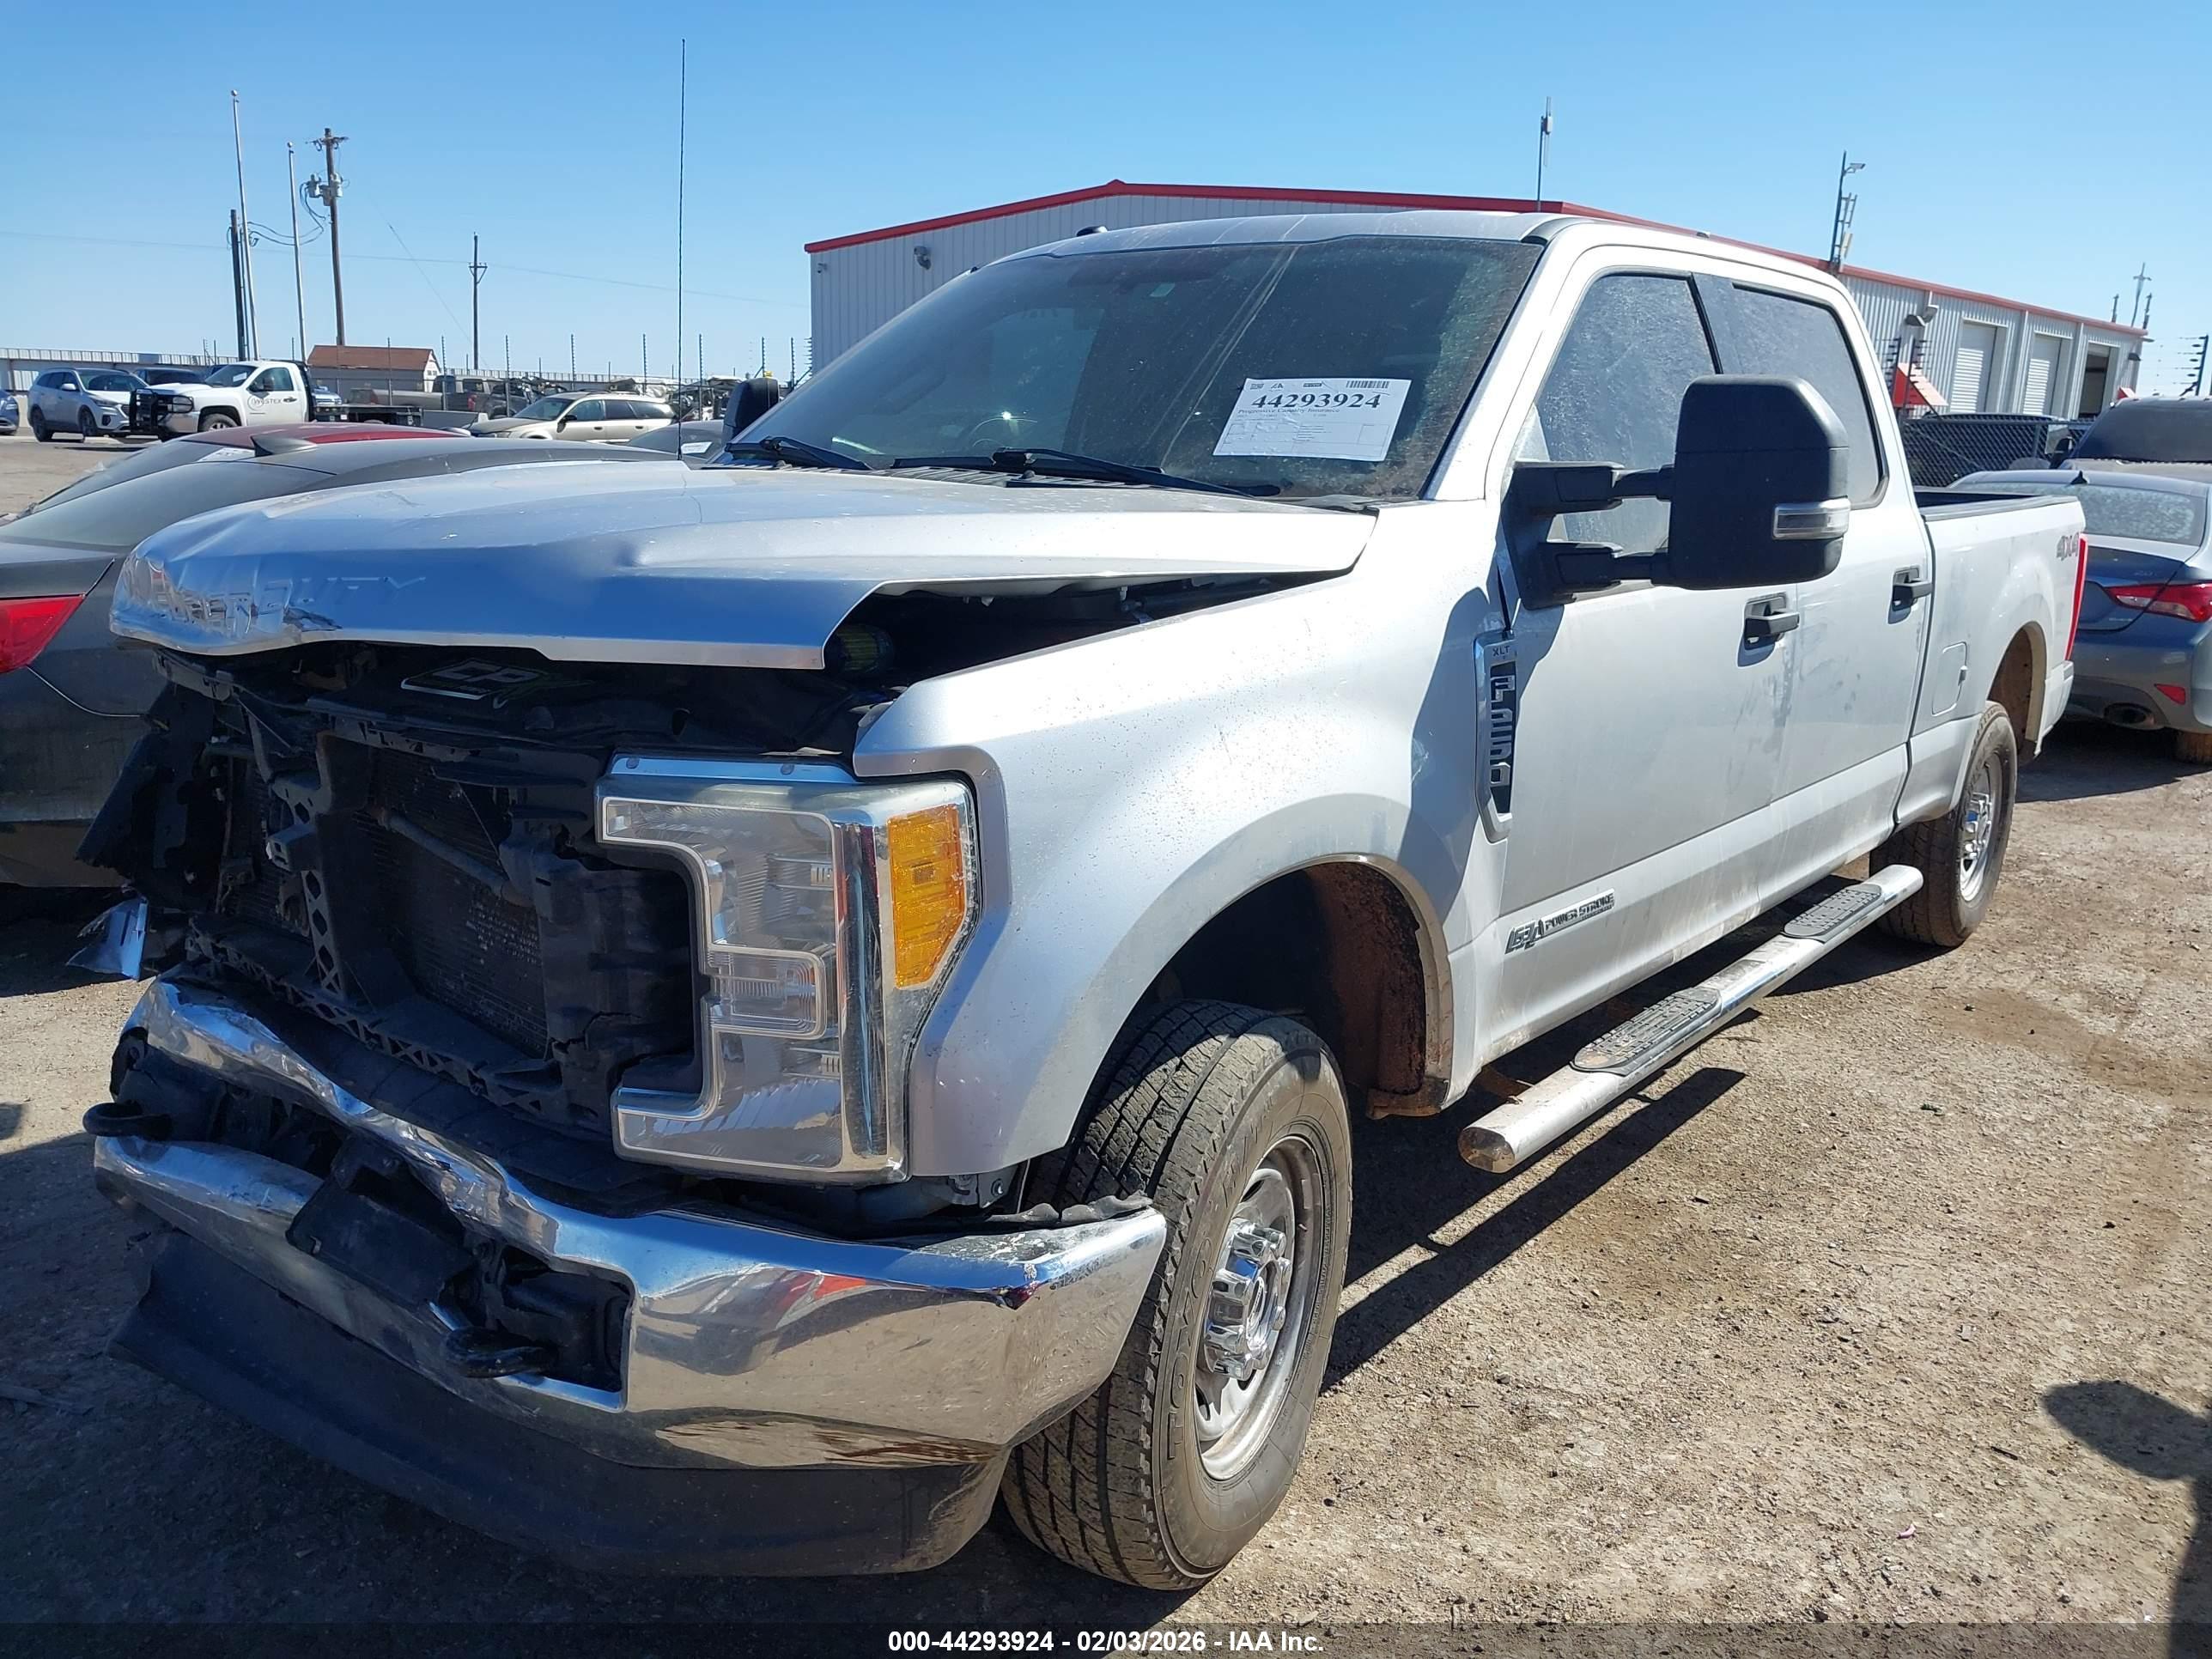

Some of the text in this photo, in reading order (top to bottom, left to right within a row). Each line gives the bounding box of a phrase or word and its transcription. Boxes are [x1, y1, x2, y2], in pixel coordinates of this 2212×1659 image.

[1251, 393, 1382, 408] 44293924
[1492, 646, 1510, 657] XLT
[1544, 908, 1578, 931] POWER
[1578, 893, 1614, 916] STROKE
[1168, 1237, 1212, 1460] TOYO
